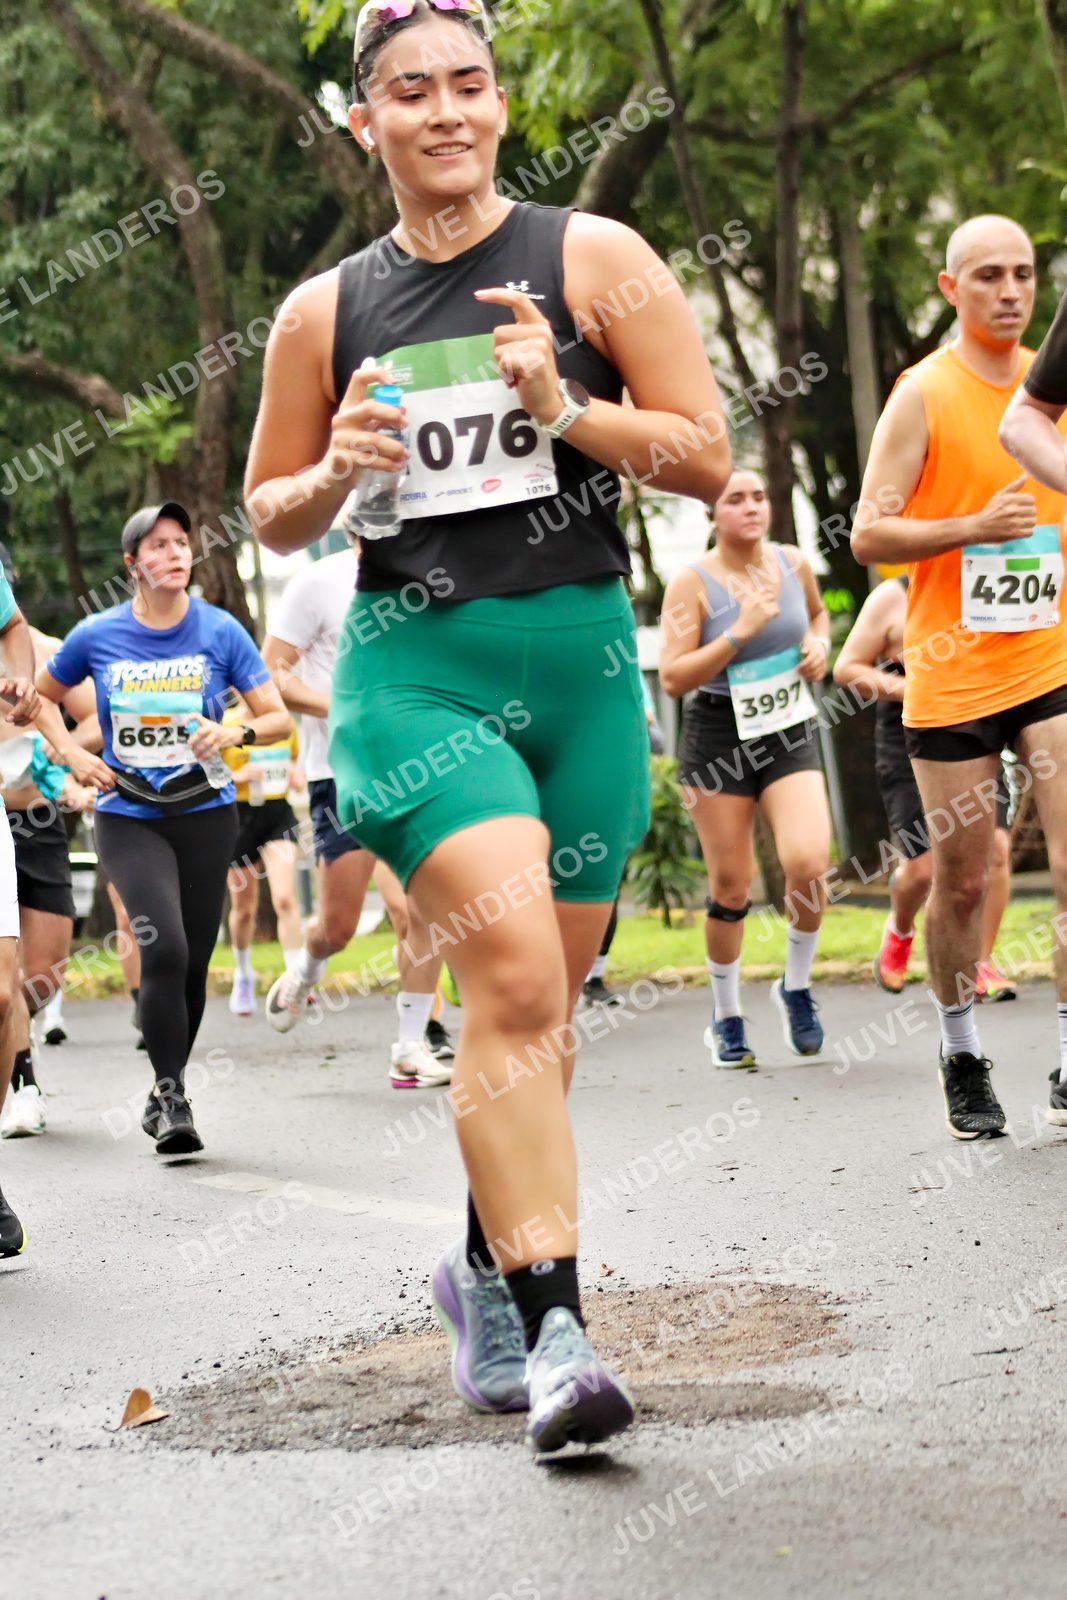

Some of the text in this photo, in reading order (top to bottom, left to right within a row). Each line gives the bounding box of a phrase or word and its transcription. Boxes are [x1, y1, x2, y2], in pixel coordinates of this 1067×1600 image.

[405, 409, 538, 476] 076
[526, 484, 551, 495] 1076
[971, 573, 1057, 605] 4204
[122, 674, 202, 692] RUNNERS
[741, 681, 801, 718] 3997
